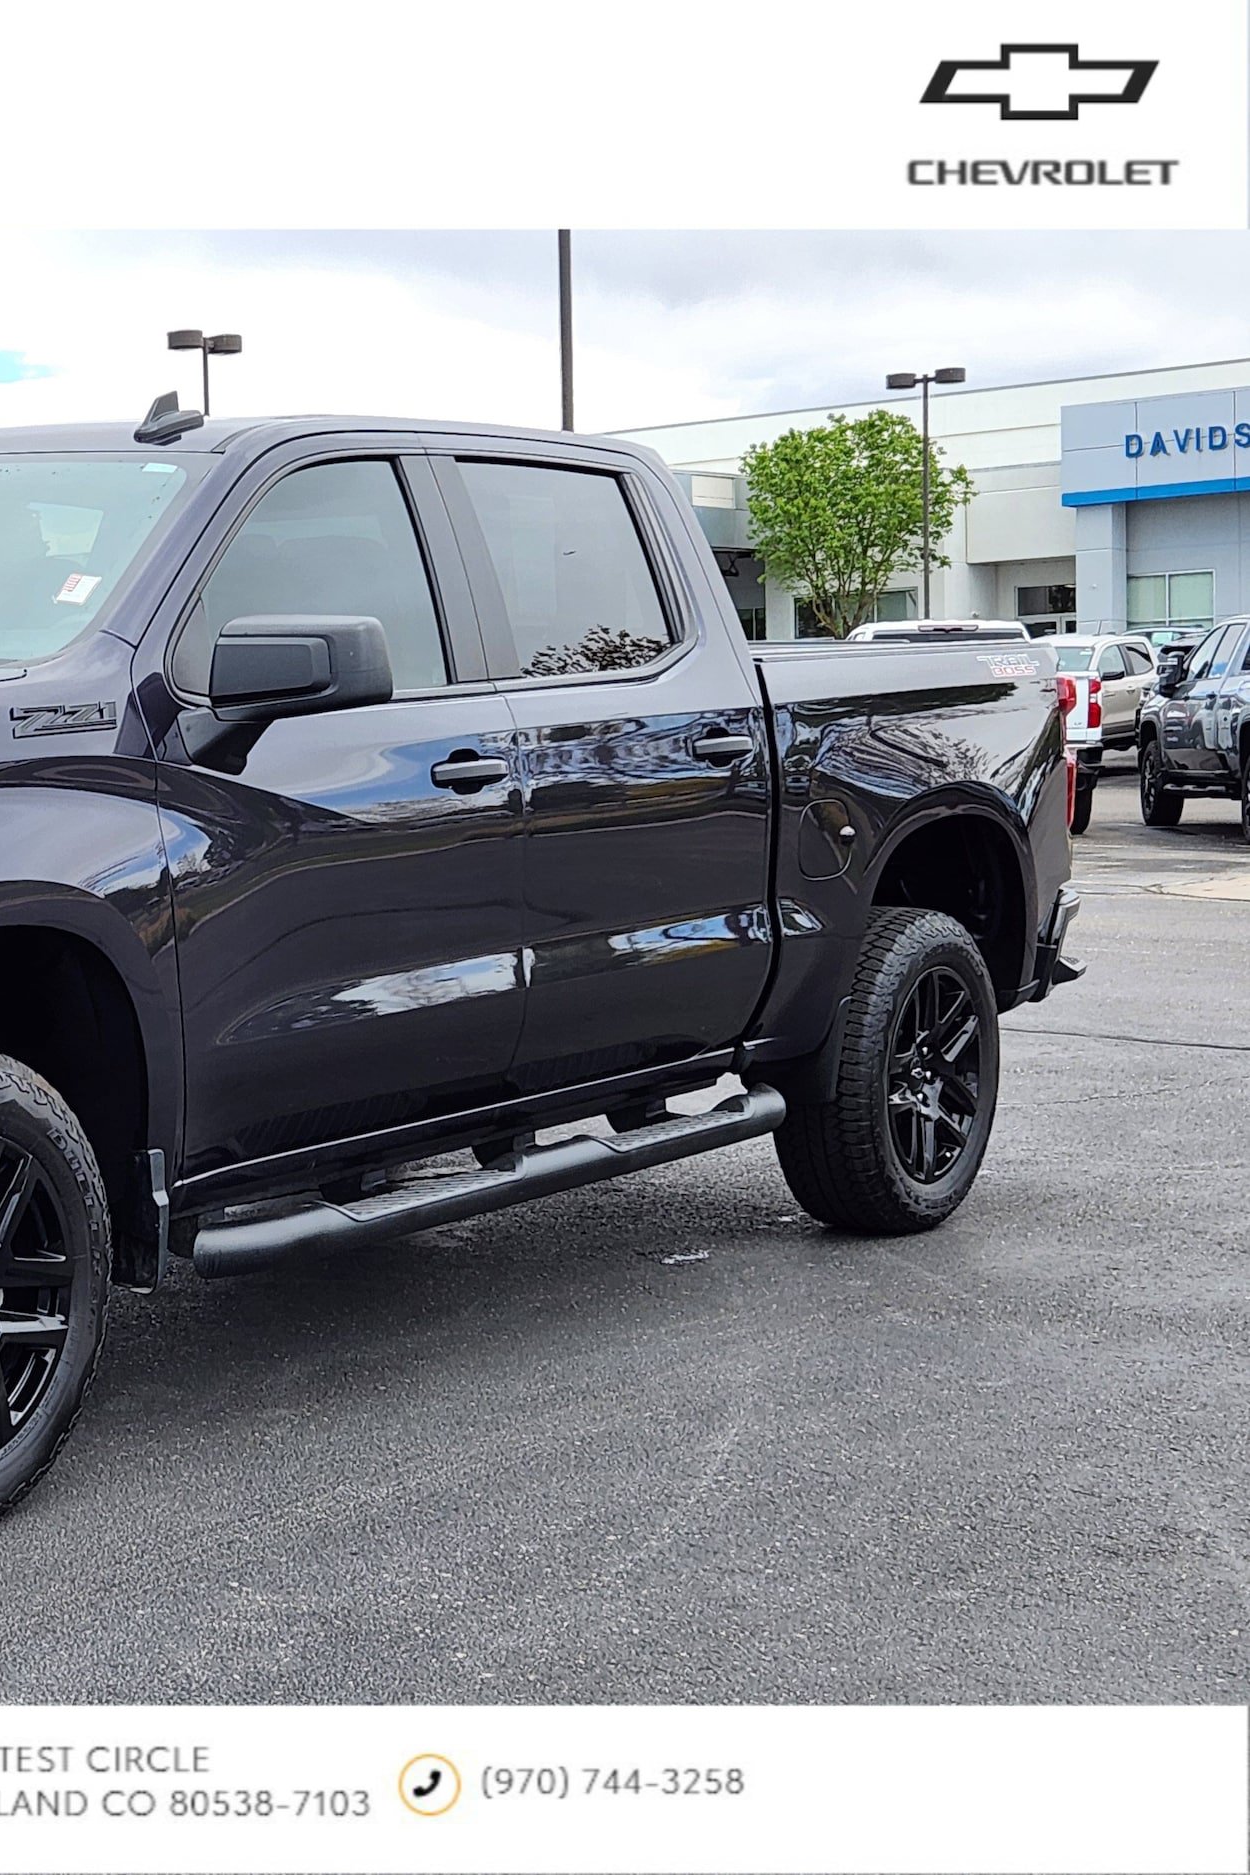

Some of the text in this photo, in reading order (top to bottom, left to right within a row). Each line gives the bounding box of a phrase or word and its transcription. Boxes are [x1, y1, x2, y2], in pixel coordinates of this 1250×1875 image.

[976, 654, 1040, 668] TRAIL
[991, 665, 1037, 678] BOSS
[9, 701, 117, 740] Z71
